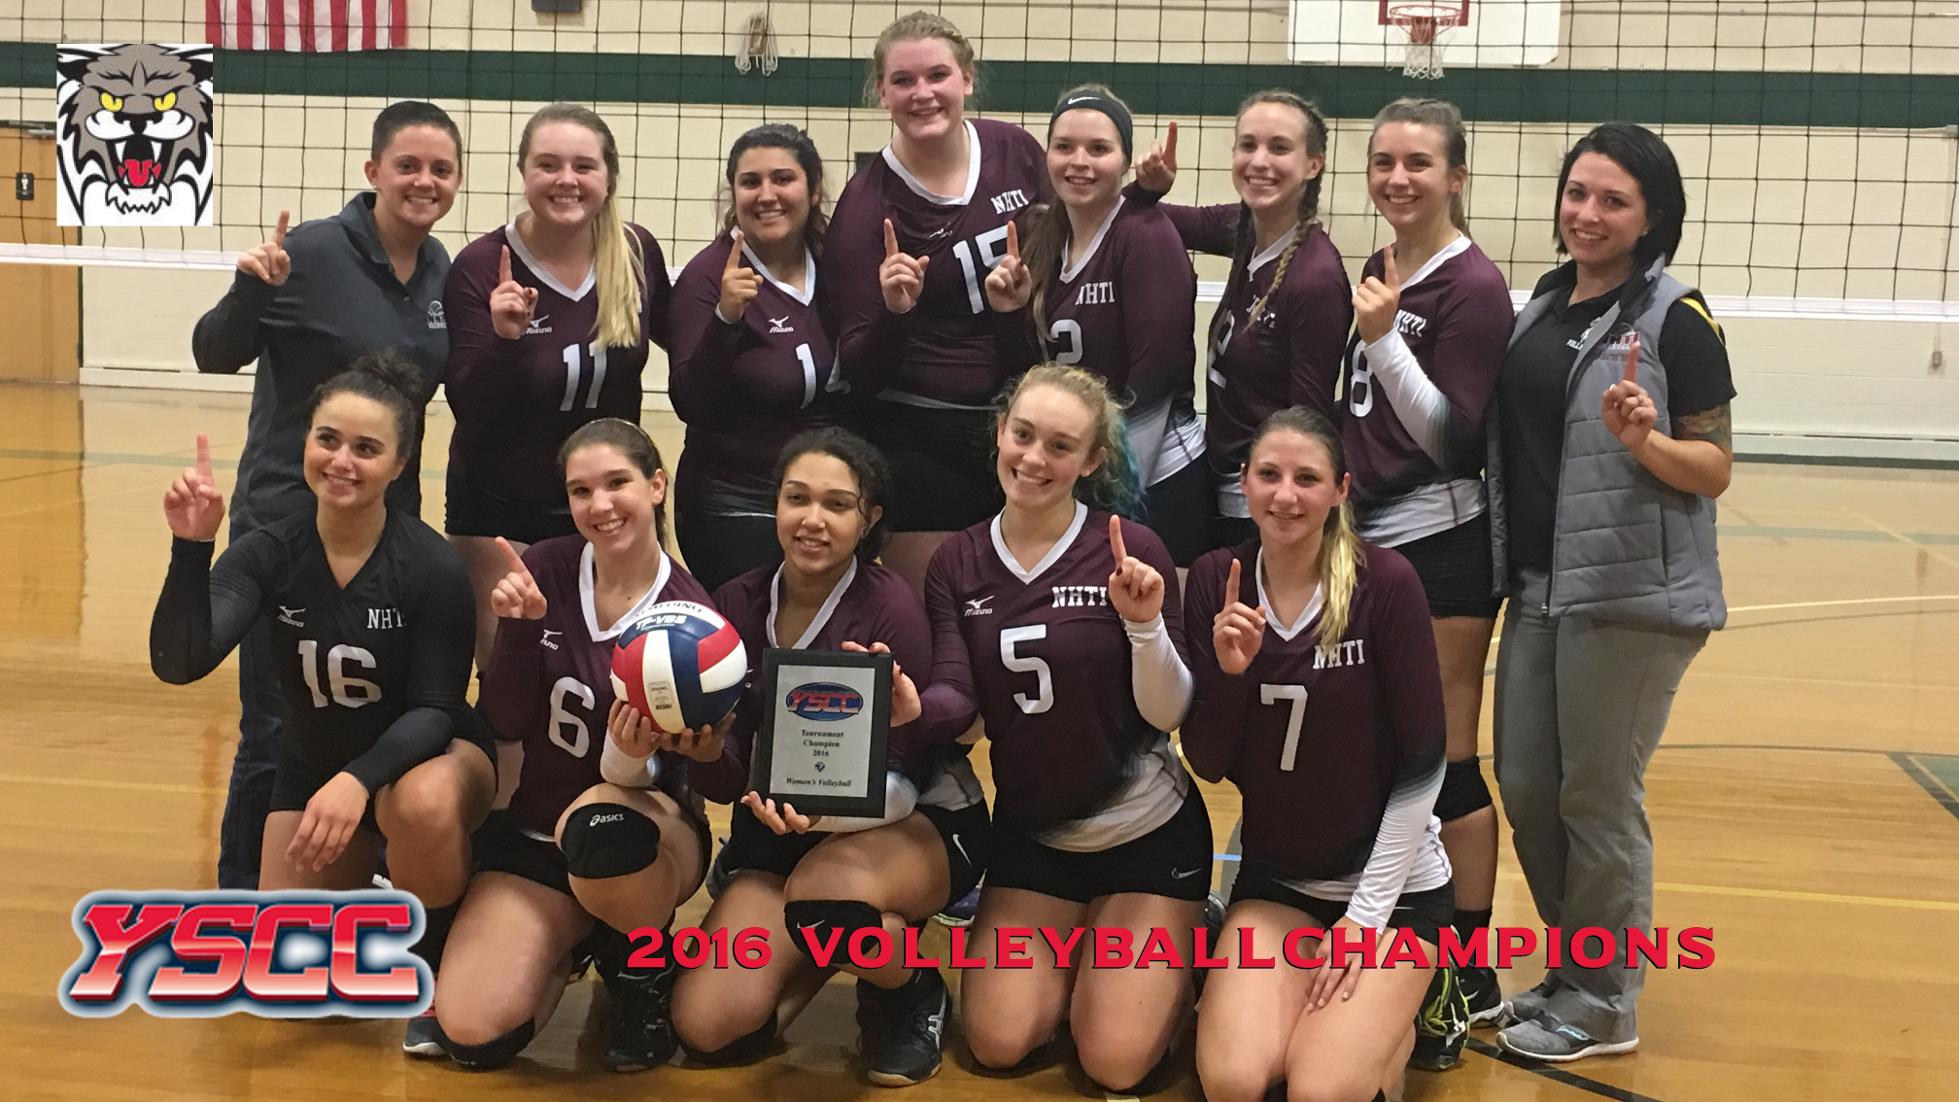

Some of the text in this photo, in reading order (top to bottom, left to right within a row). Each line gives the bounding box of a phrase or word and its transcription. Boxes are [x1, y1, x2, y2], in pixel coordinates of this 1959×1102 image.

[990, 189, 1030, 215] NHTI
[560, 340, 607, 412] 11
[1349, 339, 1373, 417] 8
[1052, 586, 1108, 608] NHTI
[367, 607, 407, 629] NHT
[1312, 639, 1365, 669] NHTI
[298, 640, 383, 708] 16
[1001, 624, 1054, 714] 5
[788, 690, 859, 713] YSCC
[549, 676, 595, 758] 6
[1260, 683, 1308, 771] 7
[801, 729, 844, 738] Tournament
[803, 739, 840, 749] Champion
[812, 749, 829, 757] 2016
